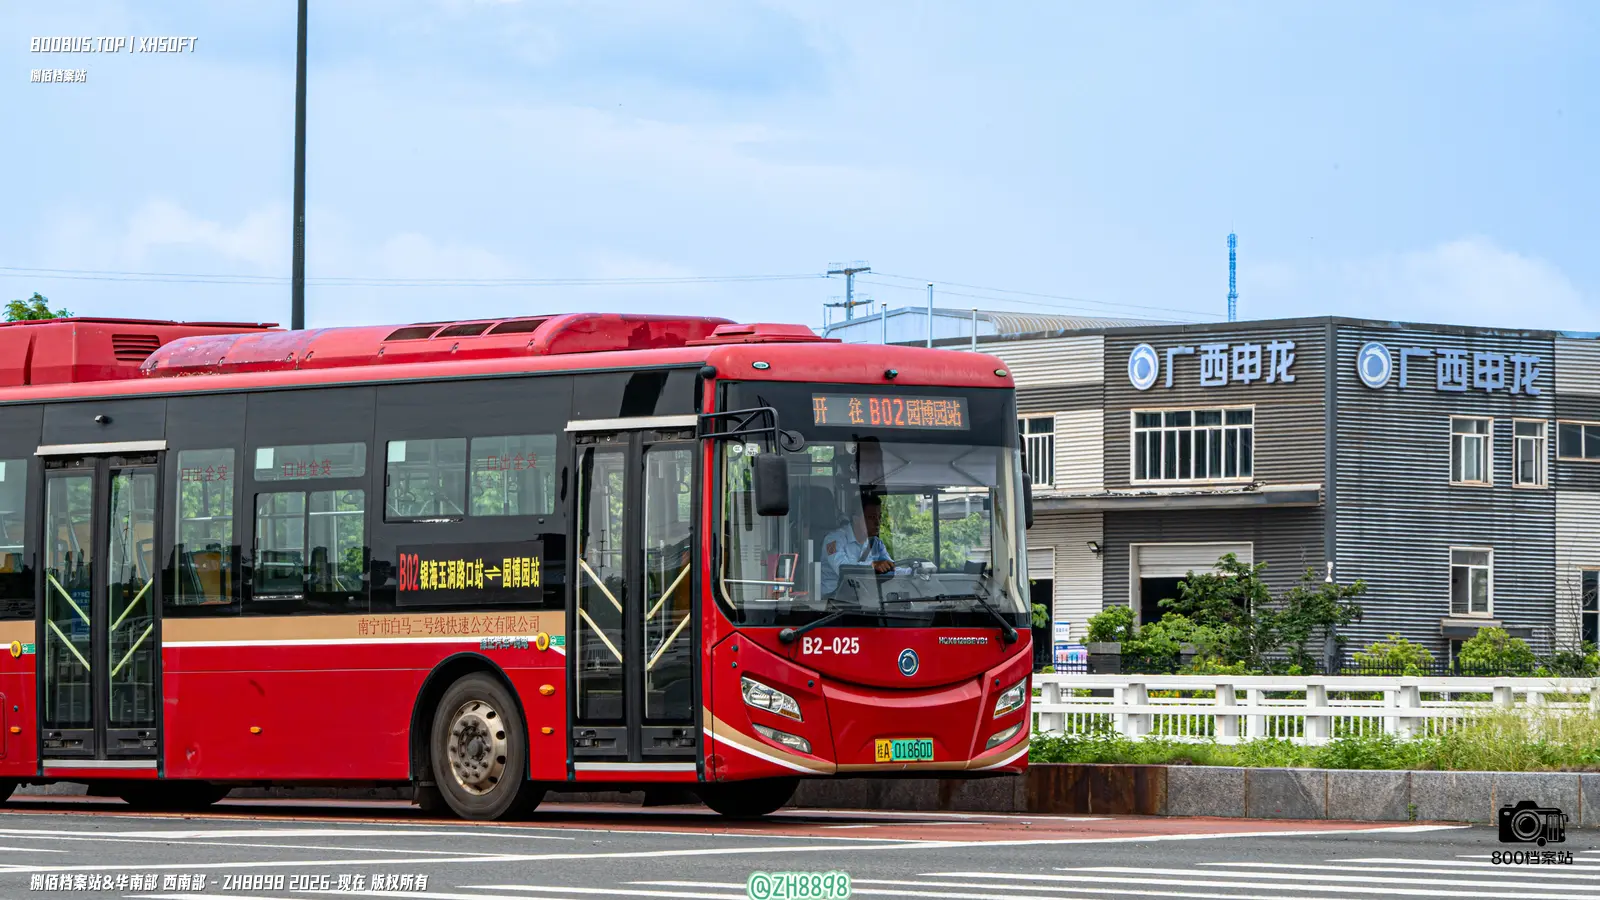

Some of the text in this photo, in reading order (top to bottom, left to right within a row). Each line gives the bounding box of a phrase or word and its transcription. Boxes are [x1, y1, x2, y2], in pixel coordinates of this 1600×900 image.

[1165, 340, 1296, 388] 广西申龙
[1400, 347, 1541, 395] 广西申龙
[502, 557, 540, 588] 园博园站
[358, 615, 540, 635] 南宁市白马二号线快速公交有限公司
[803, 636, 860, 655] B2-025
